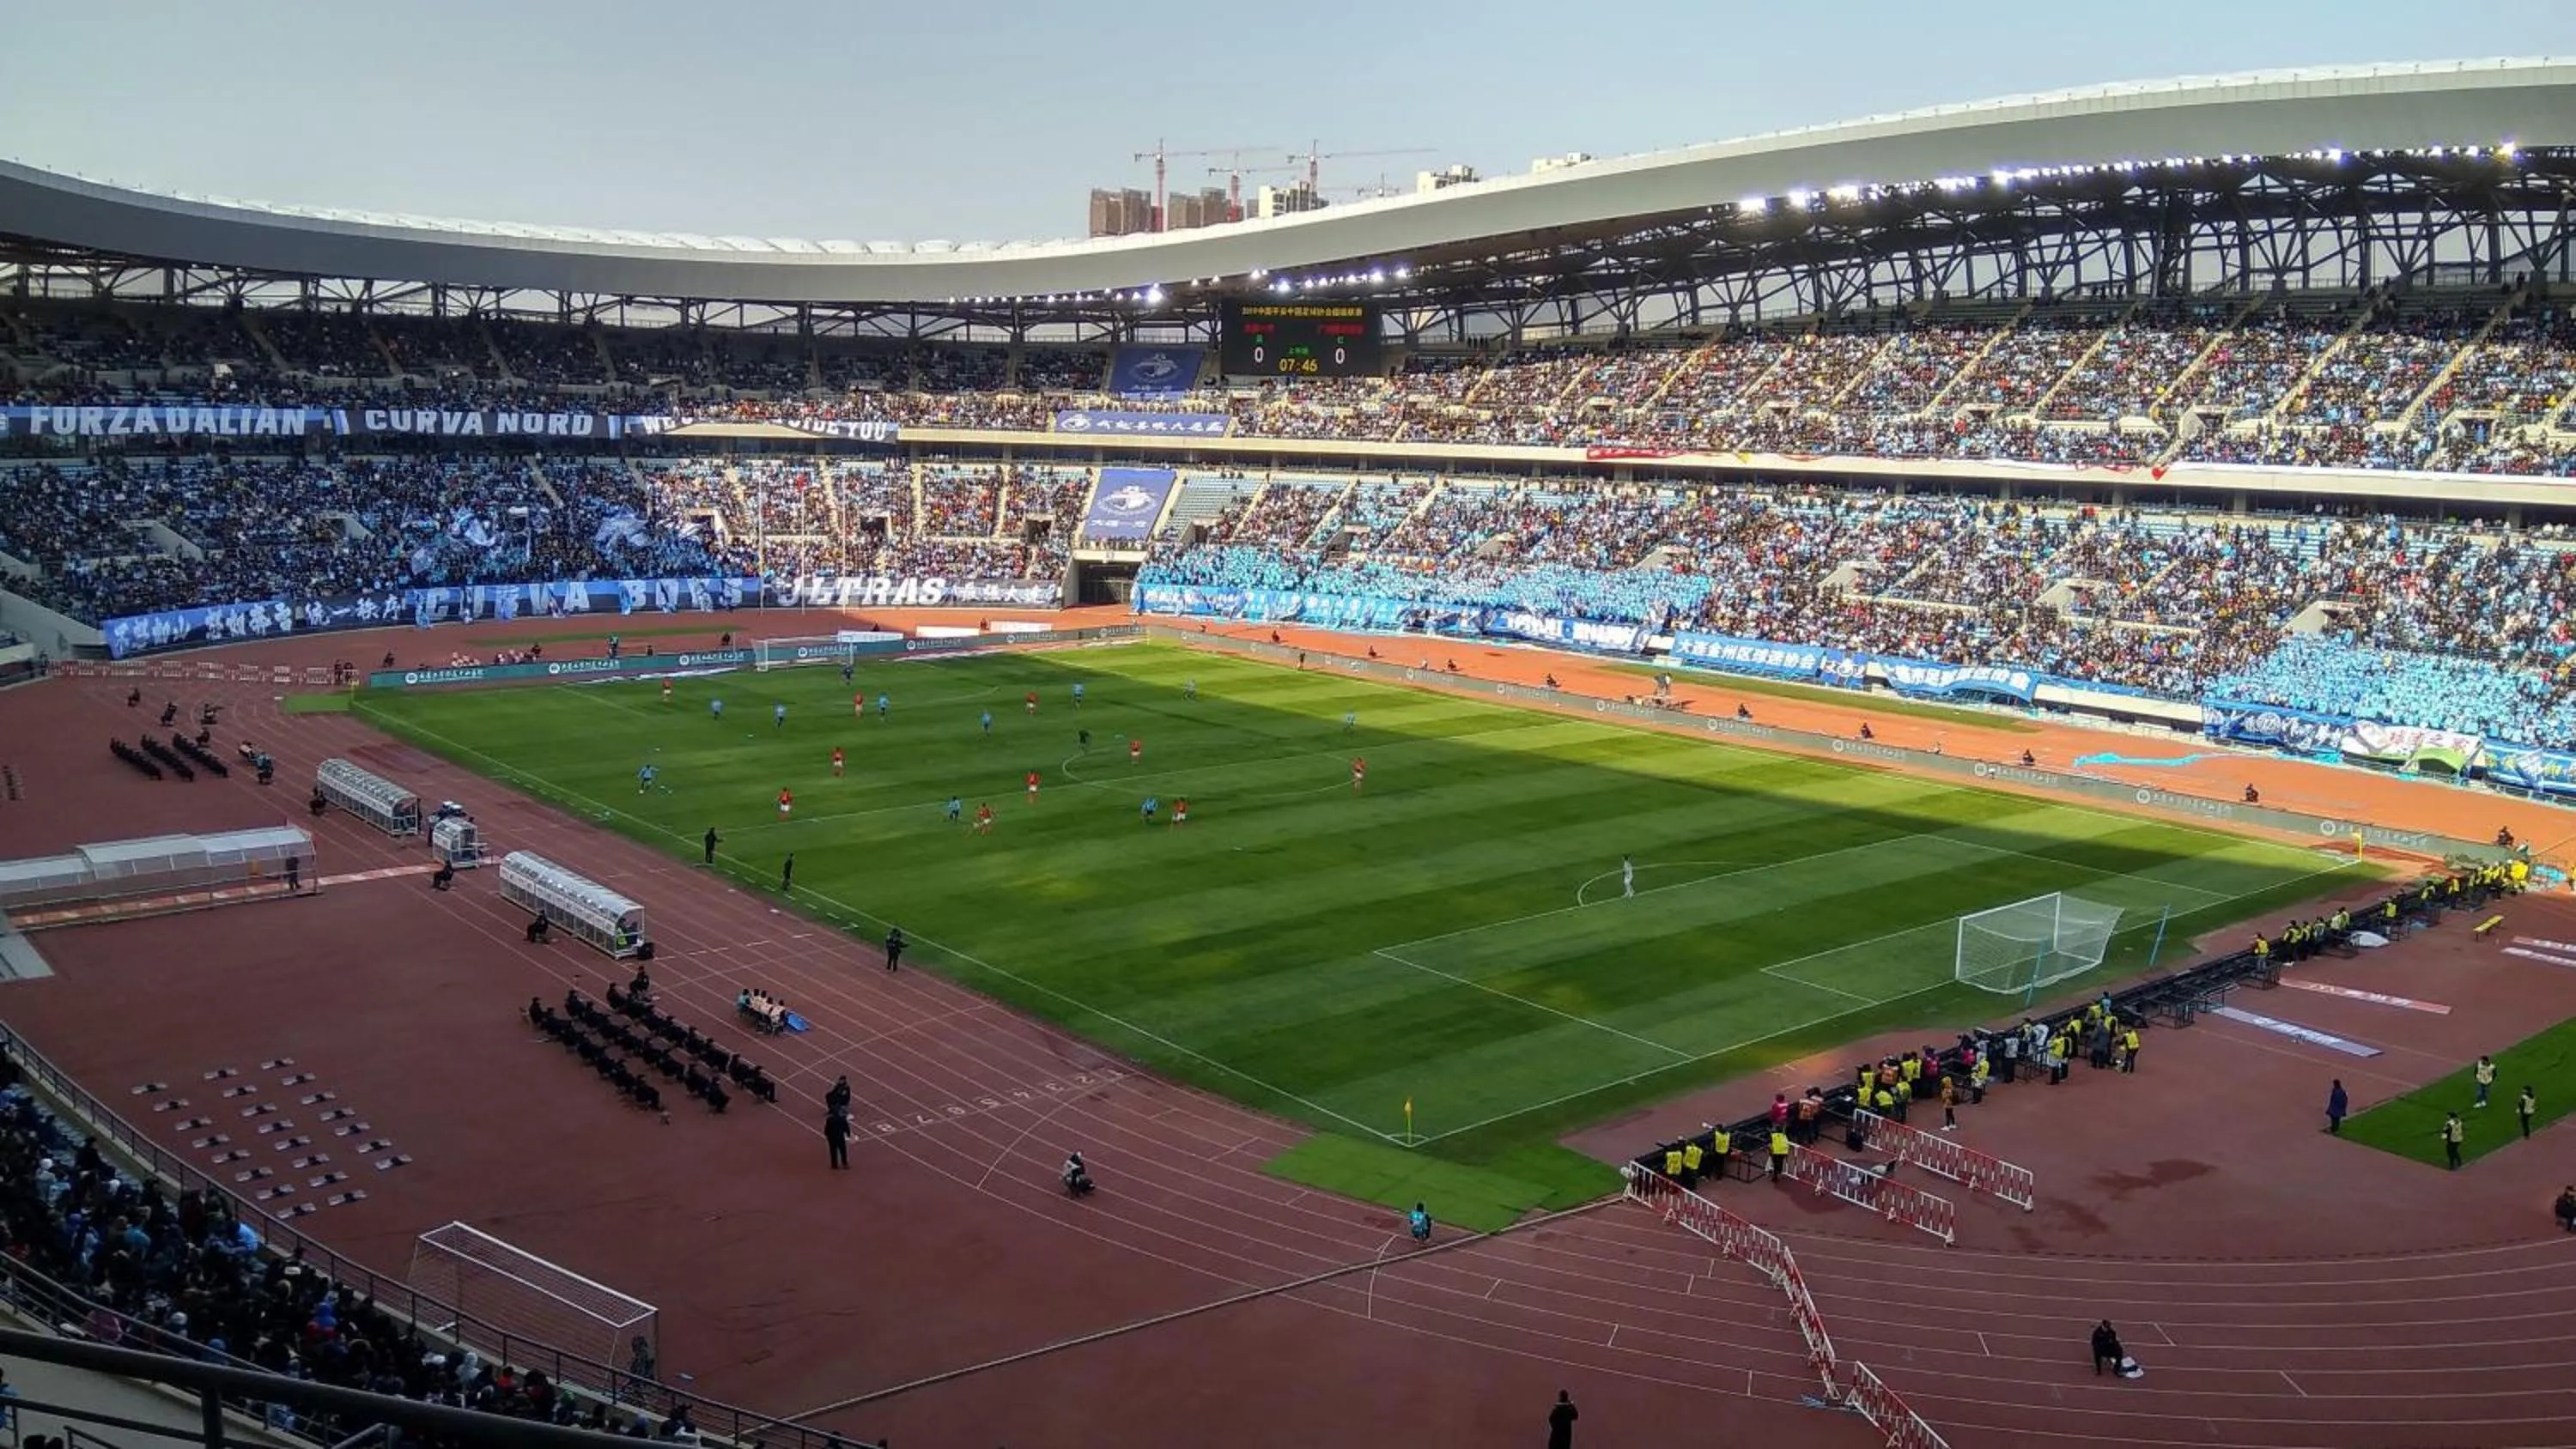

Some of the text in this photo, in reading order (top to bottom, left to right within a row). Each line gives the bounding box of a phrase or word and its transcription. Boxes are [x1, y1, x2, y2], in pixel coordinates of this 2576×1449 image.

[1255, 346, 1264, 363] 0
[1335, 347, 1346, 365] 0
[1279, 358, 1318, 372] 07:46
[30, 406, 161, 435] FORZA
[166, 408, 306, 435] DALIAN
[365, 409, 593, 436] CURVA NORD
[848, 421, 887, 440] YOU
